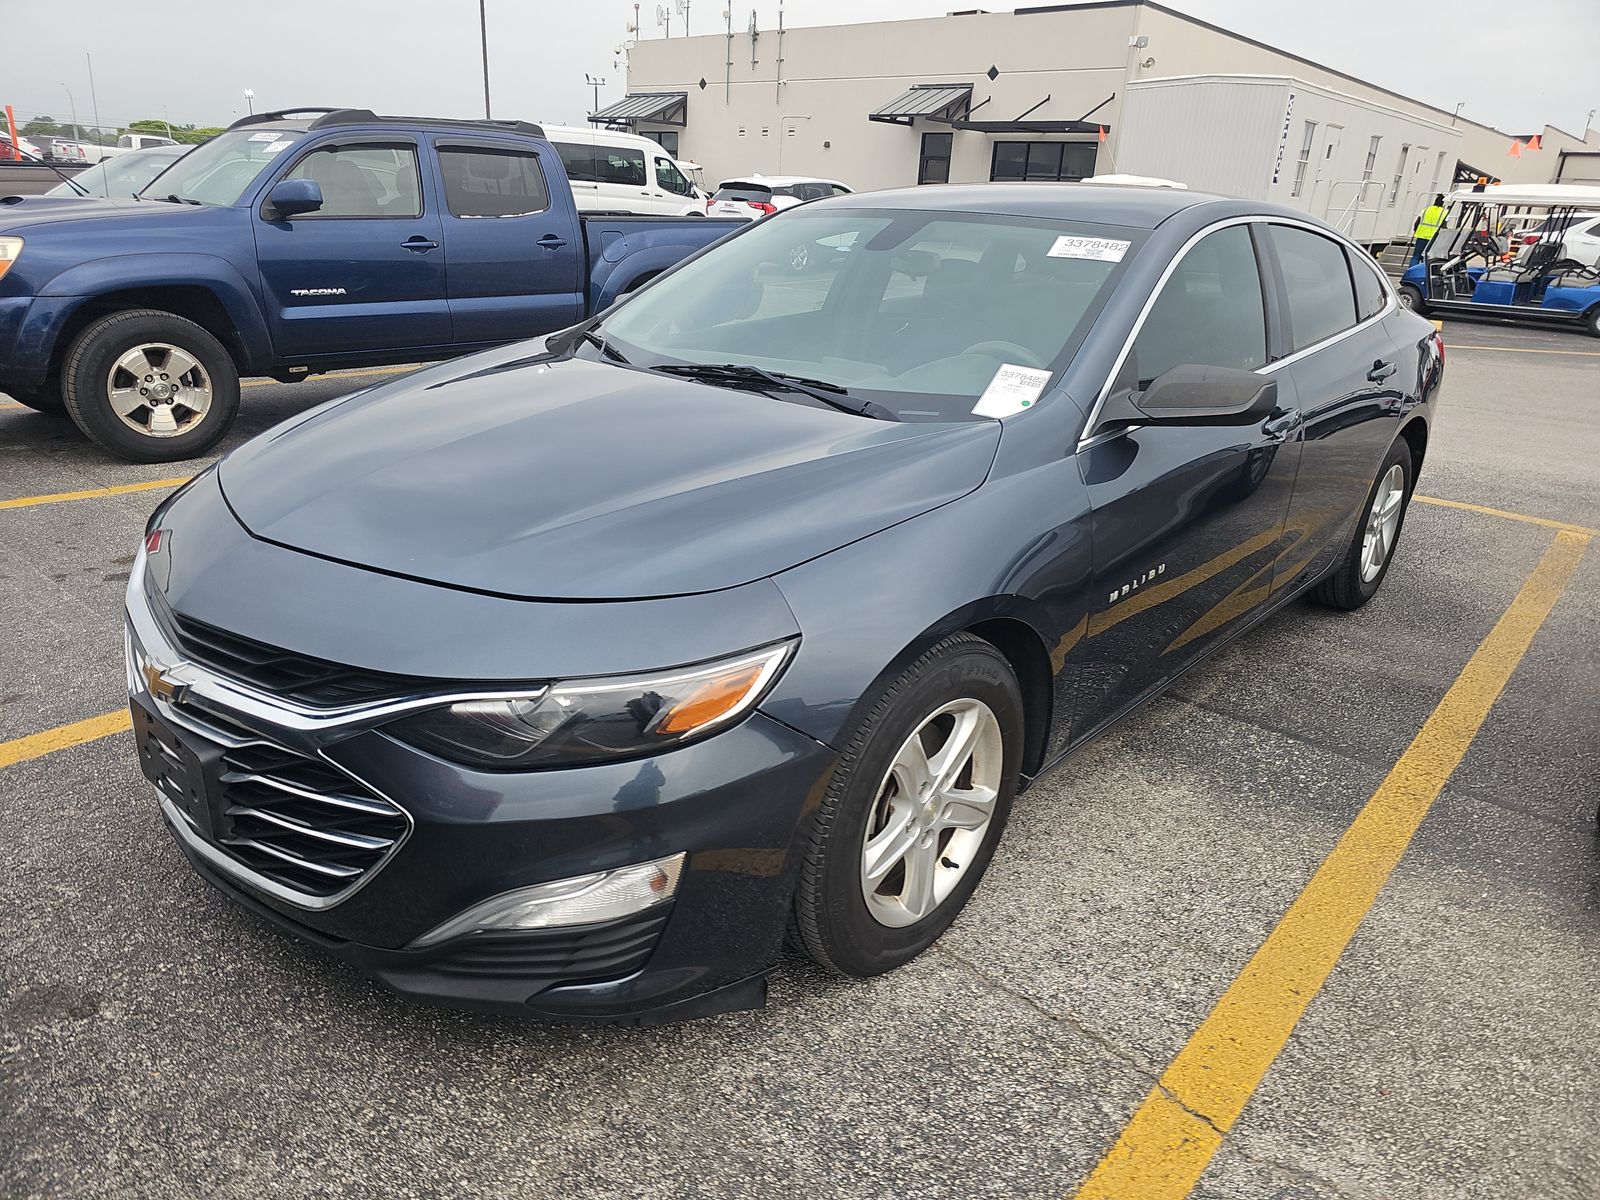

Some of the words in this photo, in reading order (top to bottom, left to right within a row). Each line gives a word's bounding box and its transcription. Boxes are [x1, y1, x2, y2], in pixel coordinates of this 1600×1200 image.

[1064, 238, 1129, 251] 3378482
[290, 288, 347, 296] TACOMA
[1001, 370, 1047, 384] 3378482
[1109, 563, 1166, 604] MALIBU
